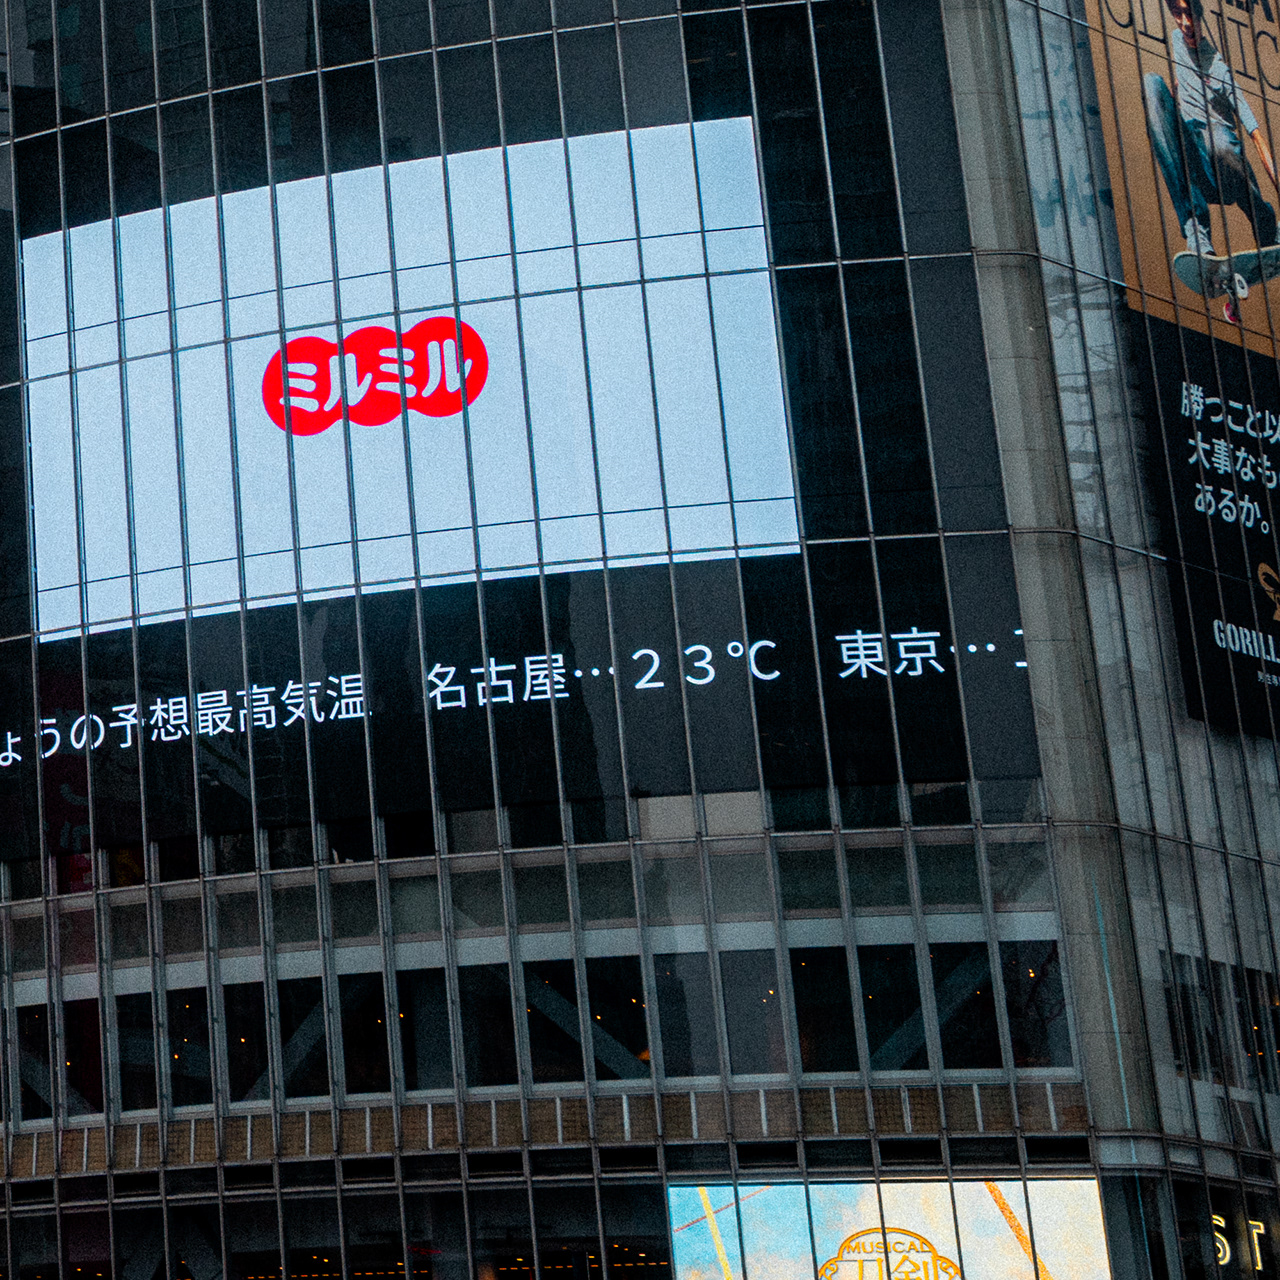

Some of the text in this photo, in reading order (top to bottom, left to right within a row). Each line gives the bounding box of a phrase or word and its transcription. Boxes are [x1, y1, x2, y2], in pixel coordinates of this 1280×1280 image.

[278, 338, 473, 413] ミルミル
[1187, 430, 1280, 491] 大事なも
[1194, 481, 1270, 535] あるか。
[845, 1240, 933, 1254] MUSICAL
